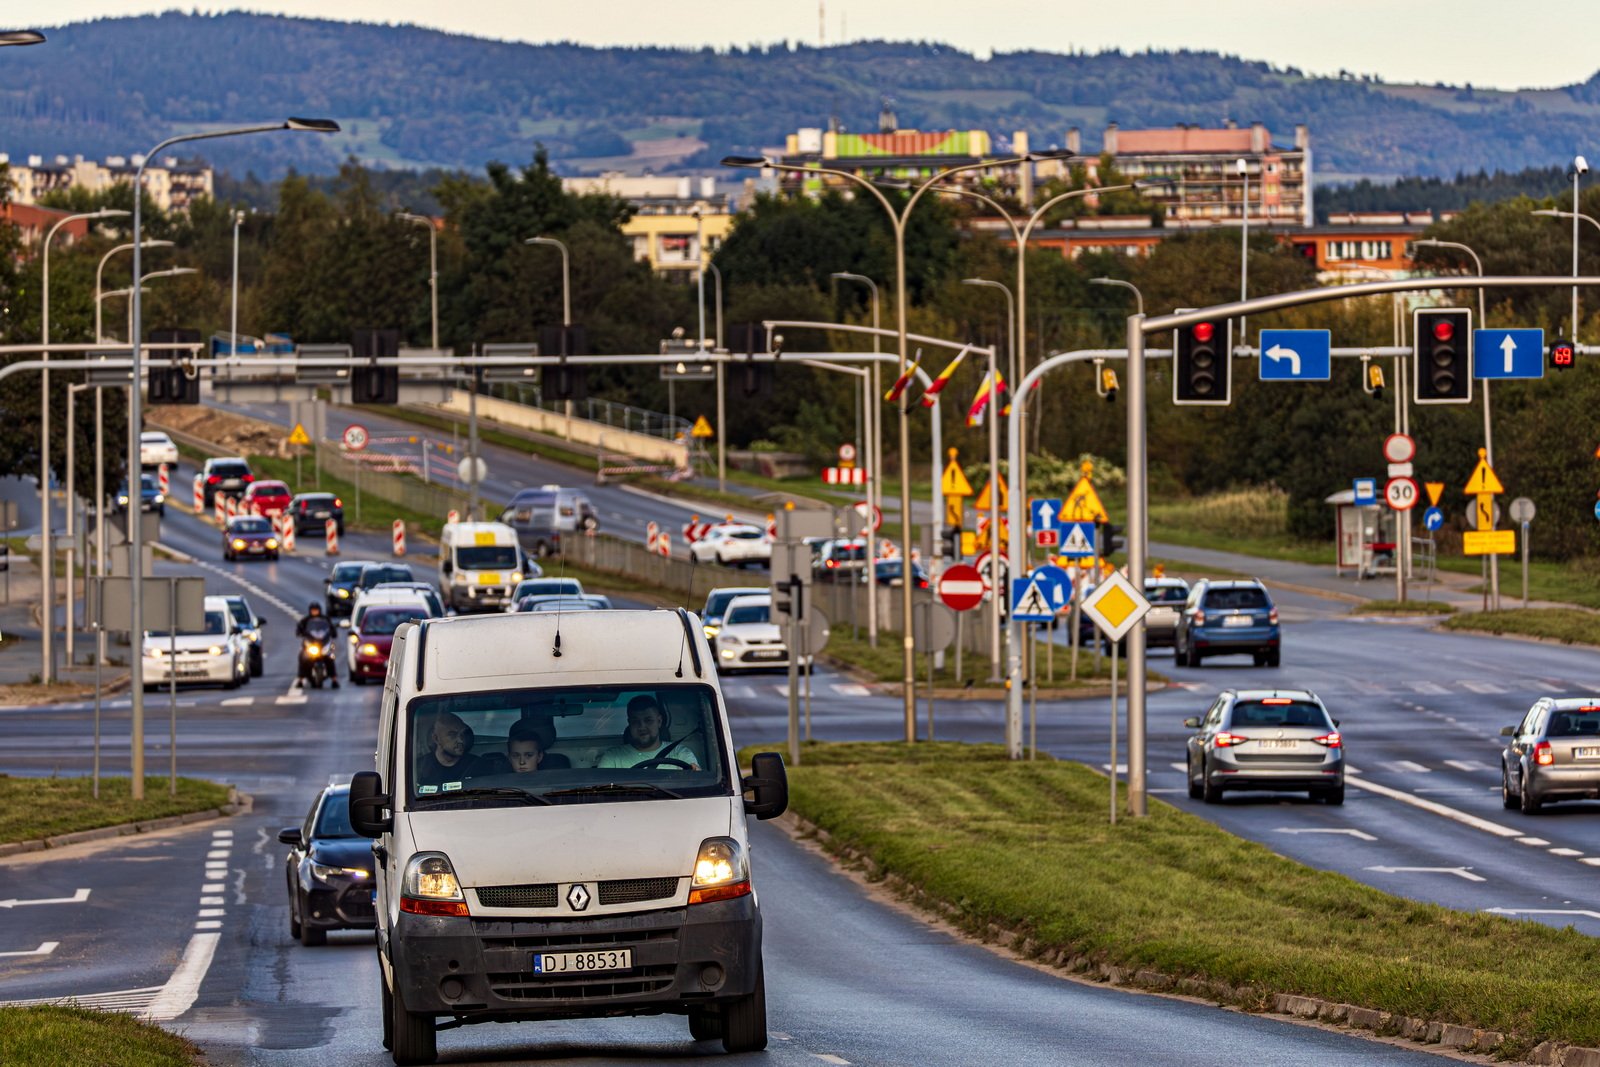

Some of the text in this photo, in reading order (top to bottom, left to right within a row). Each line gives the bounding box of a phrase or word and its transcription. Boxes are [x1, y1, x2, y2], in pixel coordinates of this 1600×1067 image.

[1391, 485, 1412, 500] 30
[544, 951, 626, 972] DJ 88531
